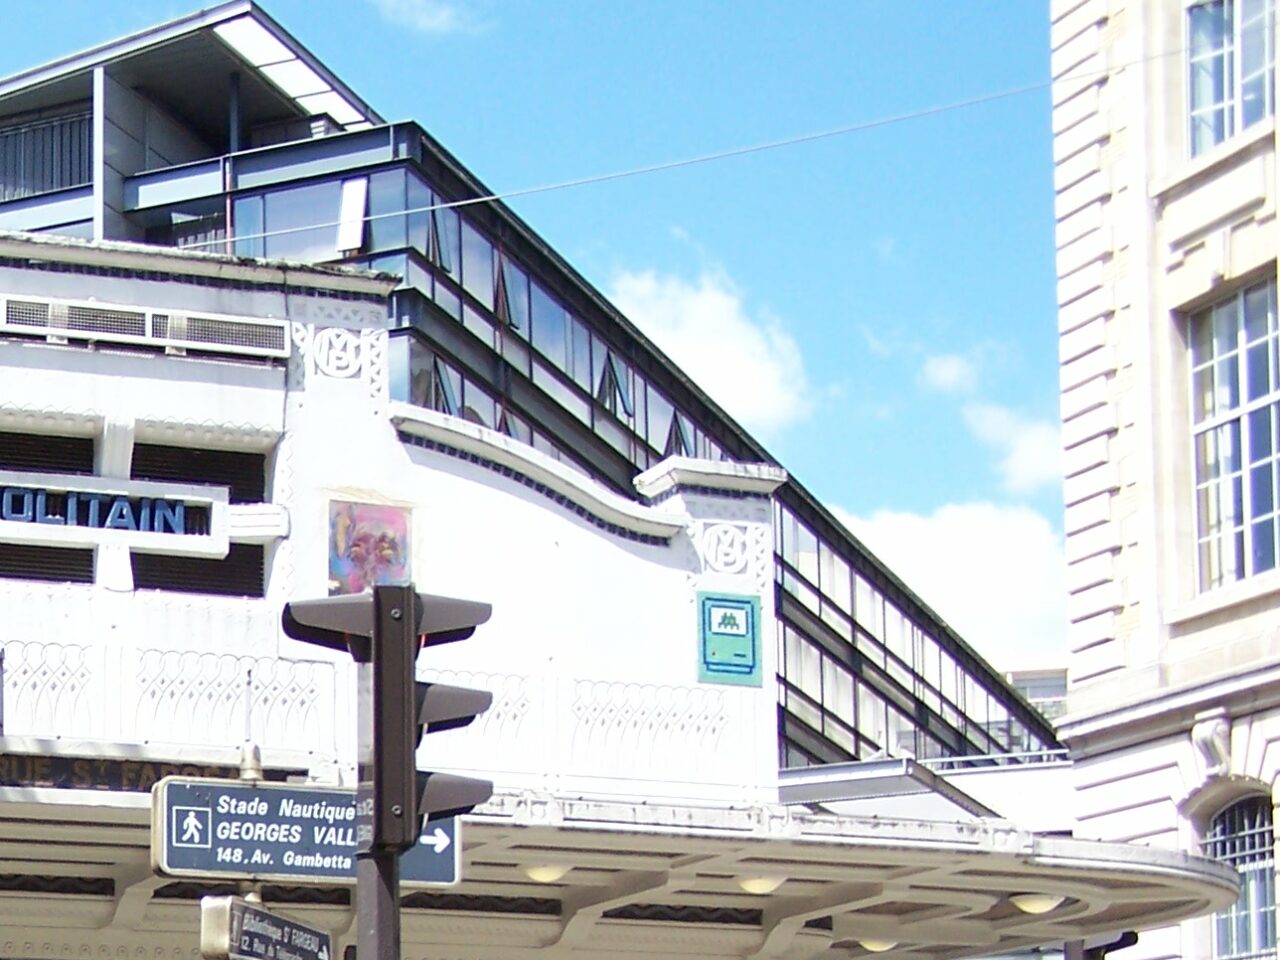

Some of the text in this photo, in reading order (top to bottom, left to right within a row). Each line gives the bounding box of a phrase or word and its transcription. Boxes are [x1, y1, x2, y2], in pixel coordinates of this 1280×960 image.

[217, 795, 269, 816] Stade
[278, 799, 356, 824] Nautique
[216, 822, 302, 844] GEORGES
[313, 825, 359, 846] VALL
[283, 850, 352, 869] Gambetta
